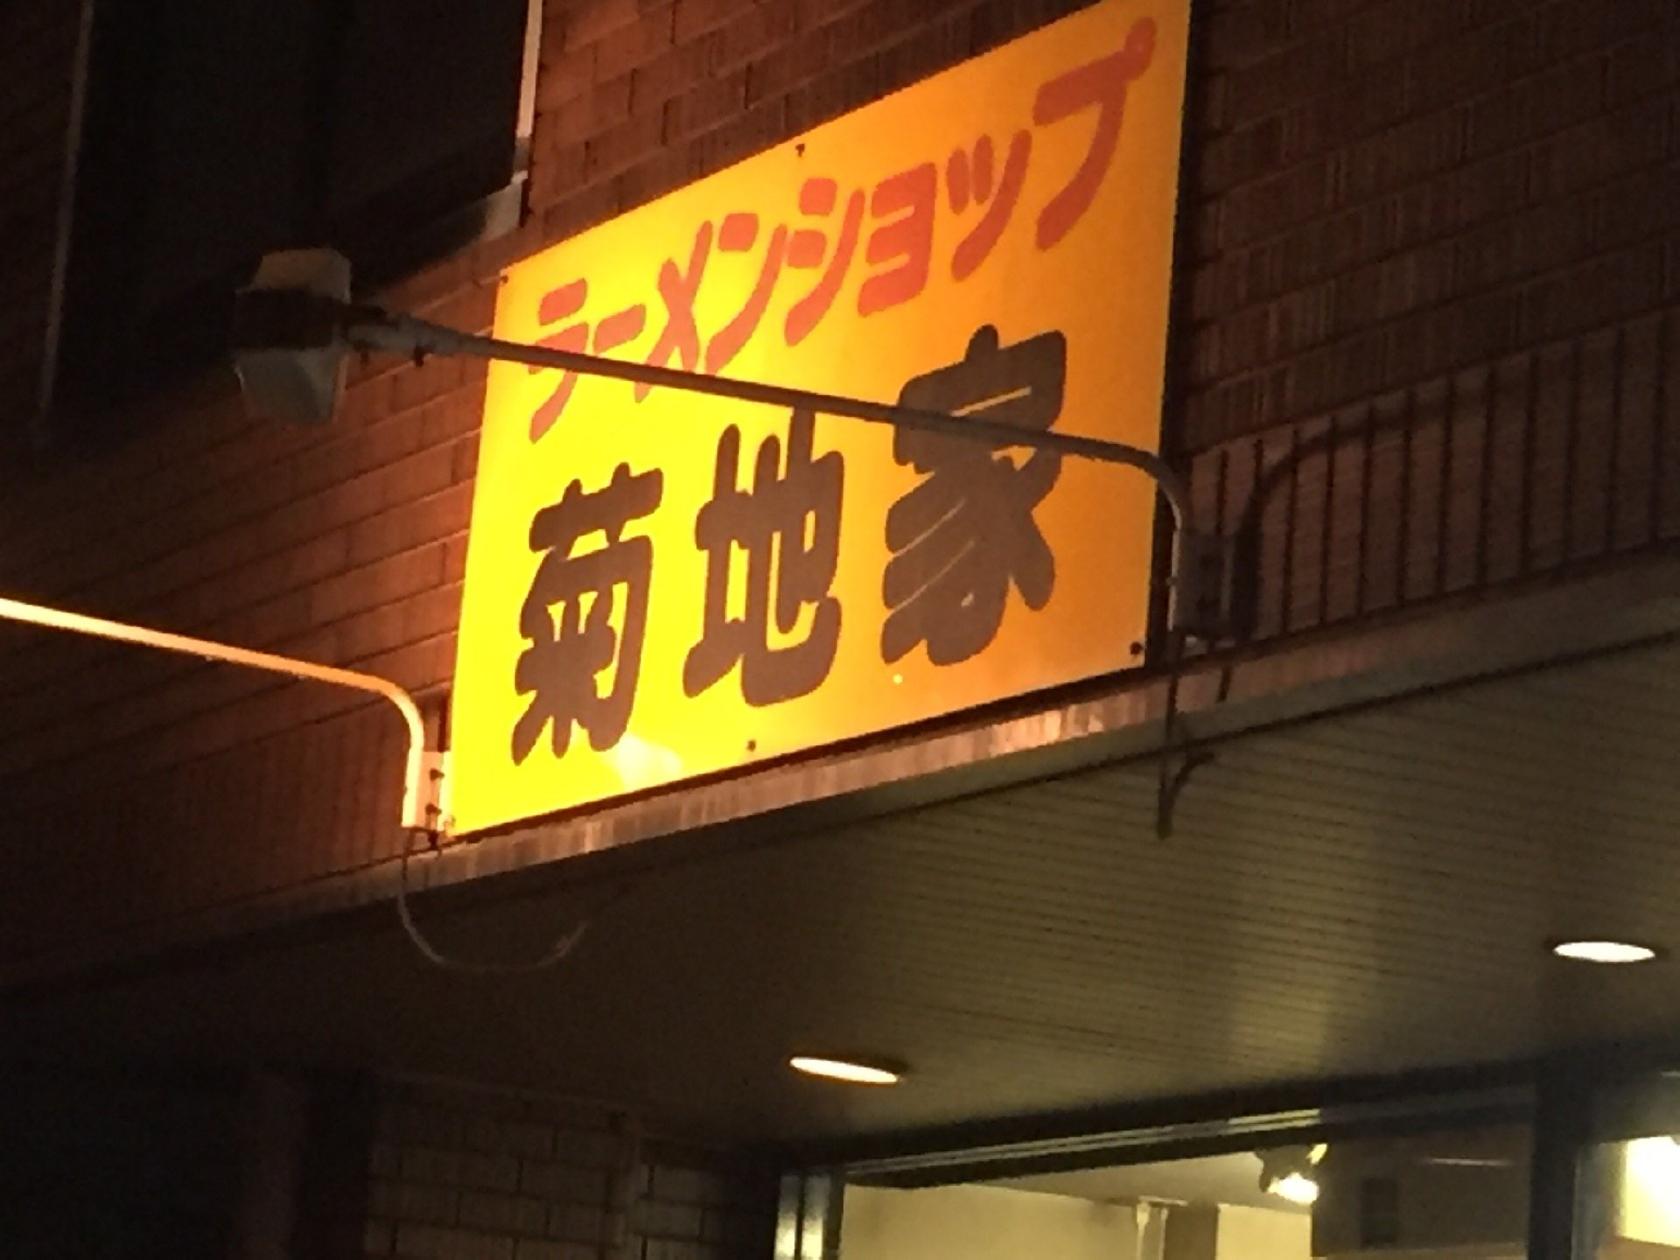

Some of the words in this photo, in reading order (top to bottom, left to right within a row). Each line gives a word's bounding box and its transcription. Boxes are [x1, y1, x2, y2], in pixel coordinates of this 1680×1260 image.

[529, 17, 1157, 443] ラーメンショップ
[512, 325, 1067, 766] 菊地家
